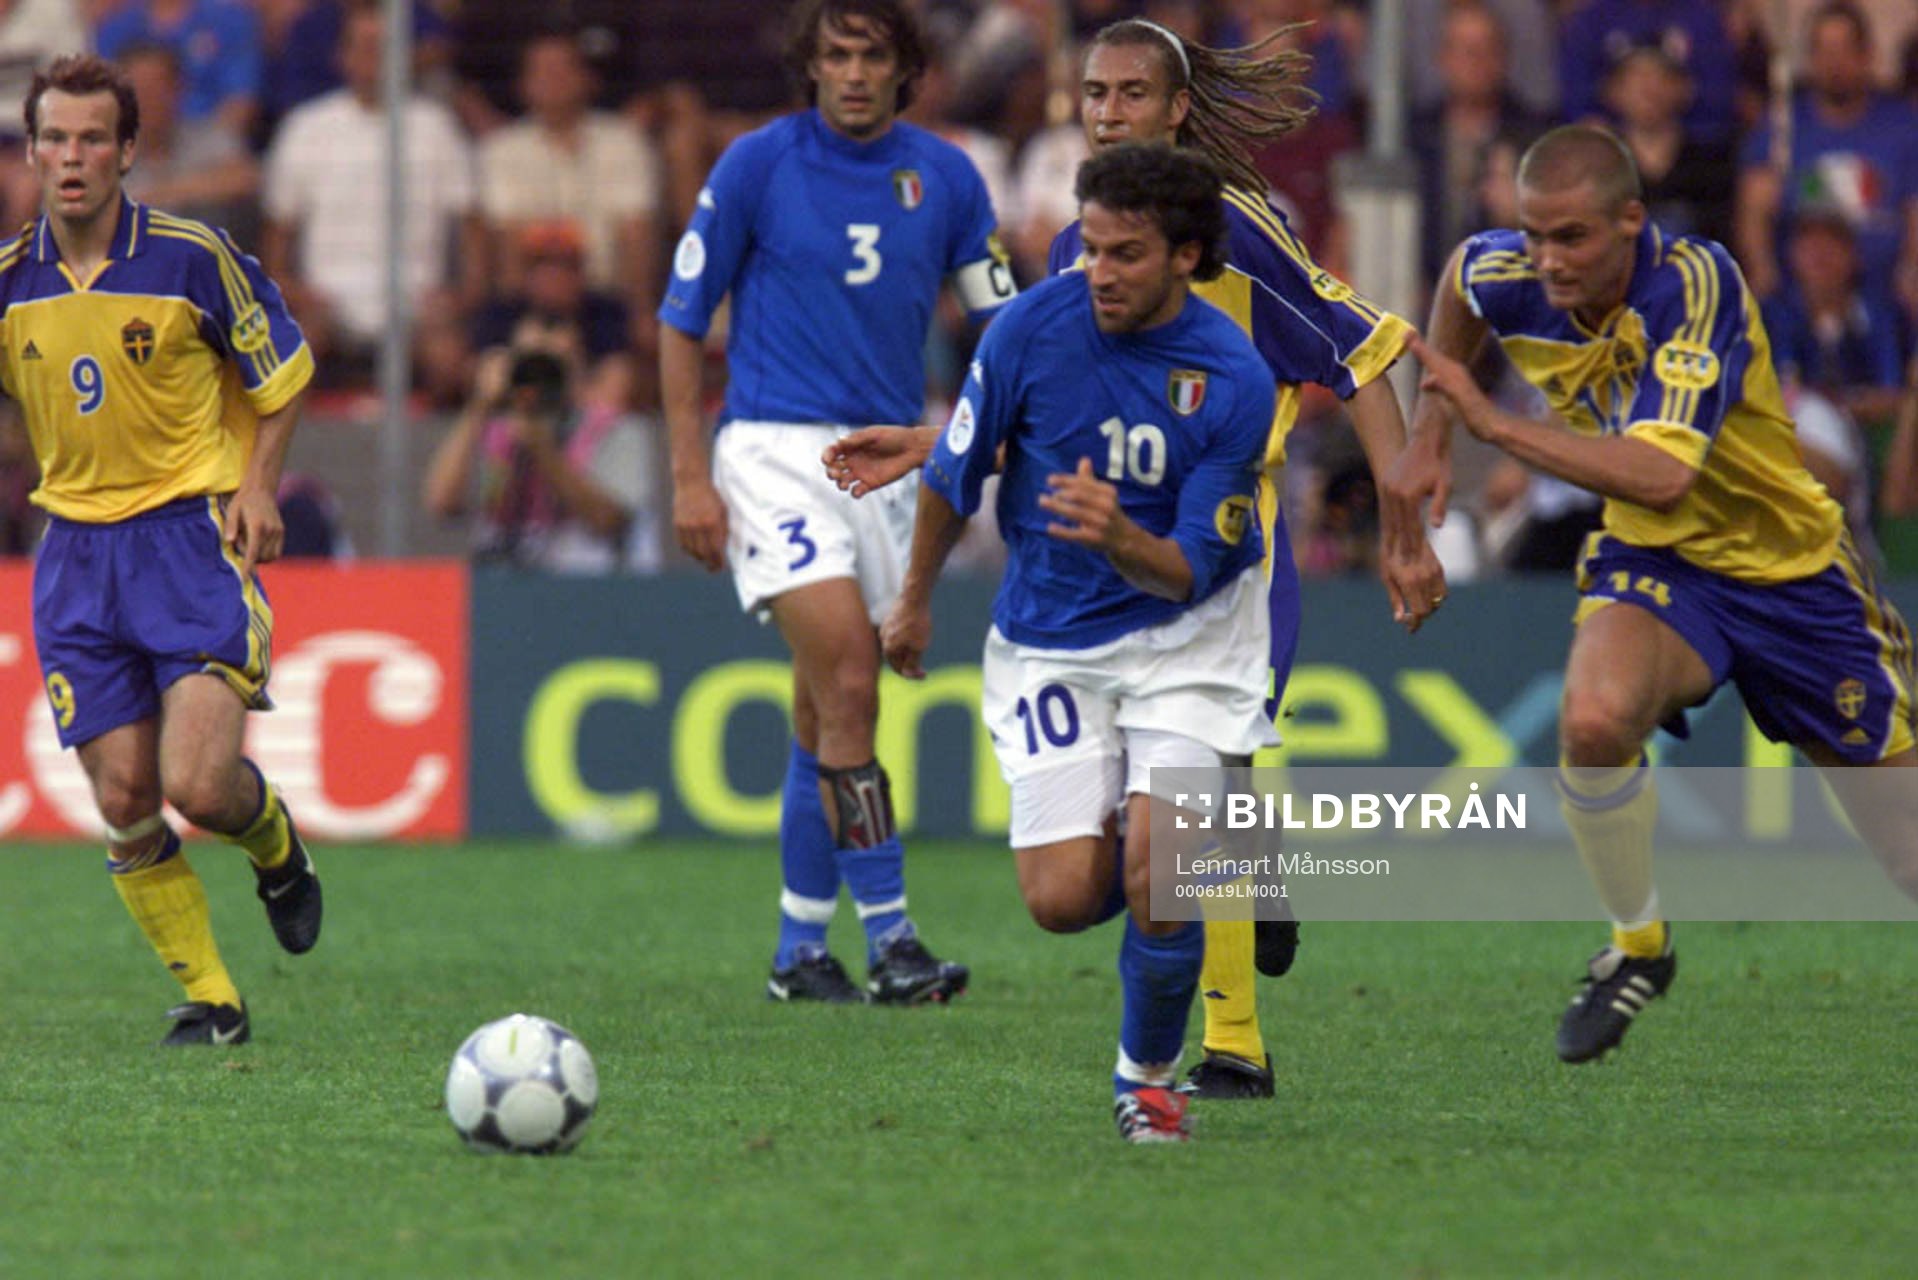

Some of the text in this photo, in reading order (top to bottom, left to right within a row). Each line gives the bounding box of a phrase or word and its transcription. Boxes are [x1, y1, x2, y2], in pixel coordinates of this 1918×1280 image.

[845, 223, 883, 285] 3
[70, 355, 105, 414] 9
[1099, 416, 1168, 487] 10
[777, 516, 817, 572] 3
[1607, 570, 1673, 606] 14
[47, 672, 76, 729] 9
[1016, 682, 1081, 756] 10
